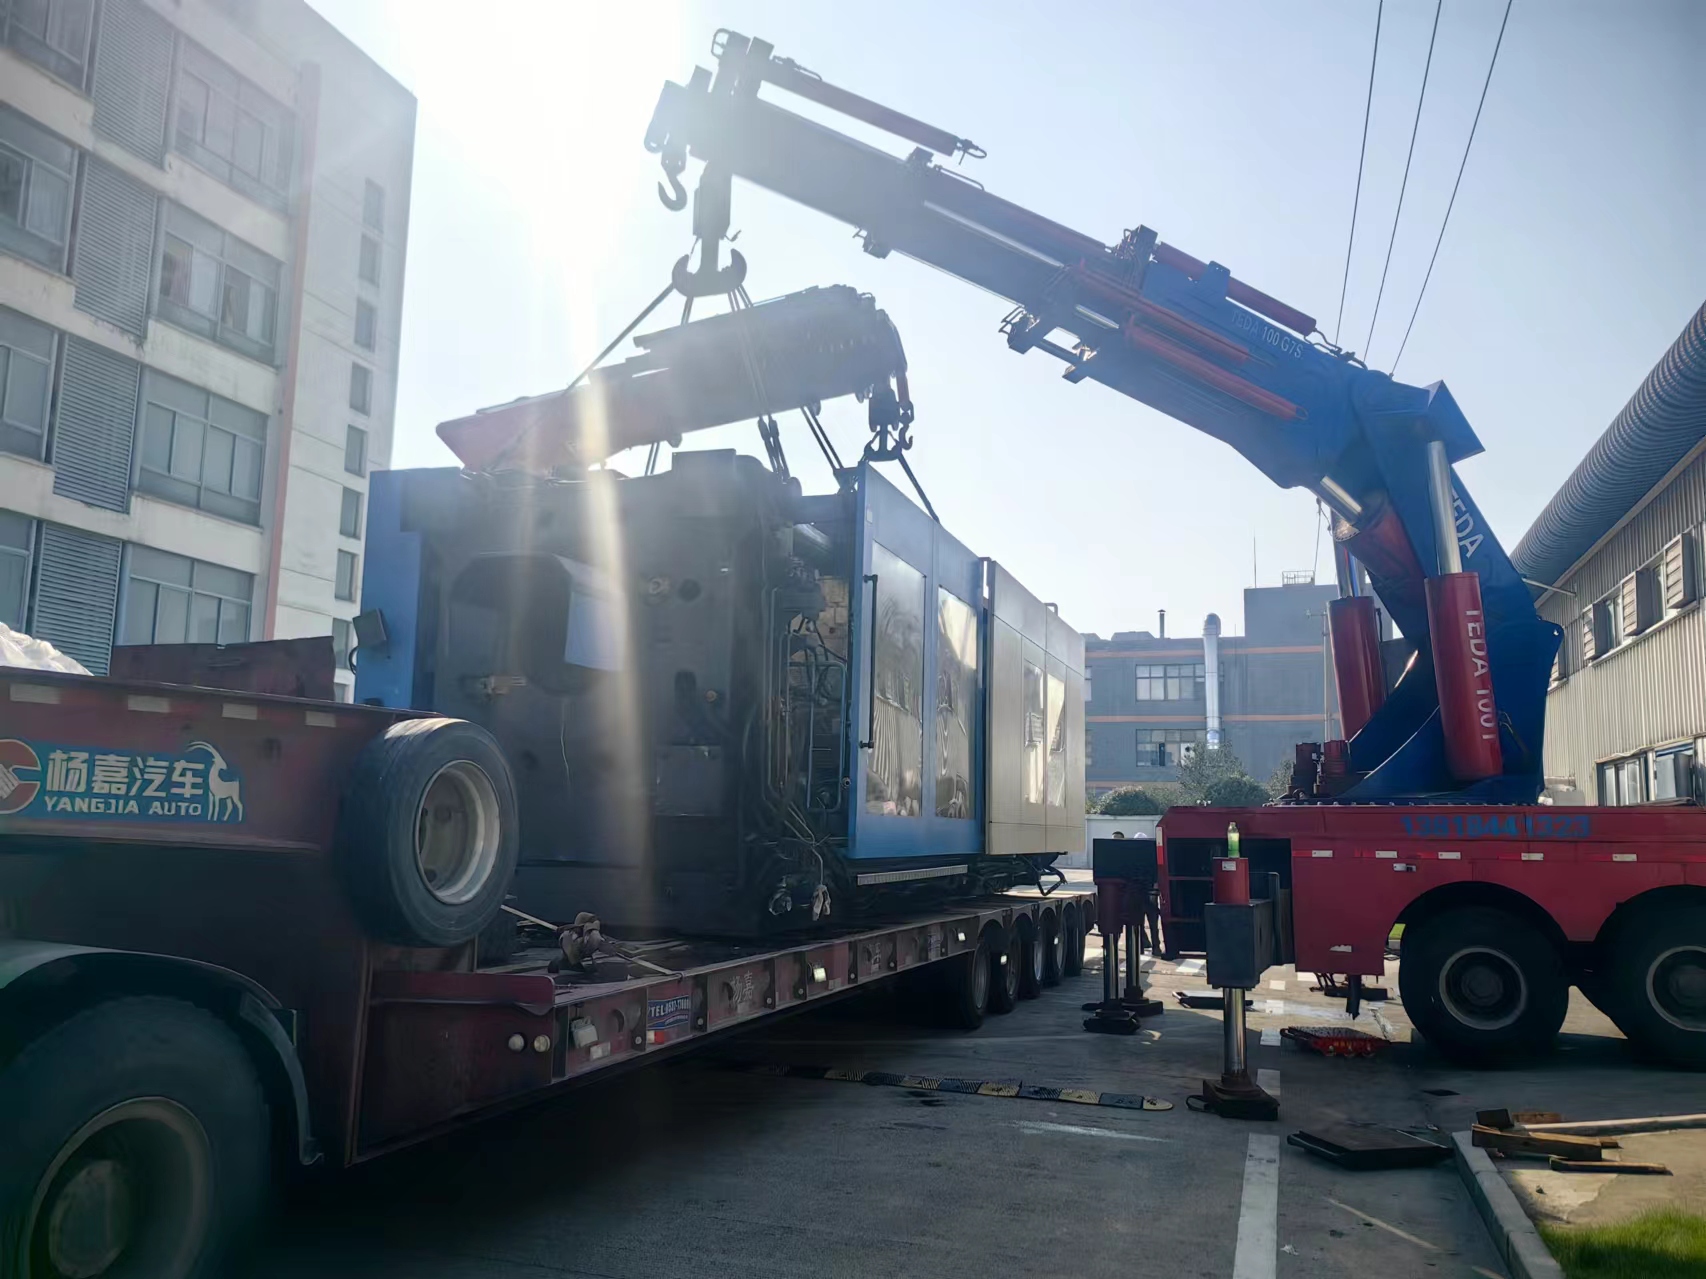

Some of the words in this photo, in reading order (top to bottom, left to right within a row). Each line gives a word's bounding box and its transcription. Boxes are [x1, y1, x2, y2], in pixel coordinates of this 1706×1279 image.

[1262, 325, 1280, 346] 100
[46, 749, 205, 798] 杨嘉汽车
[44, 795, 140, 814] YANGJIA
[148, 800, 202, 816] AUTO
